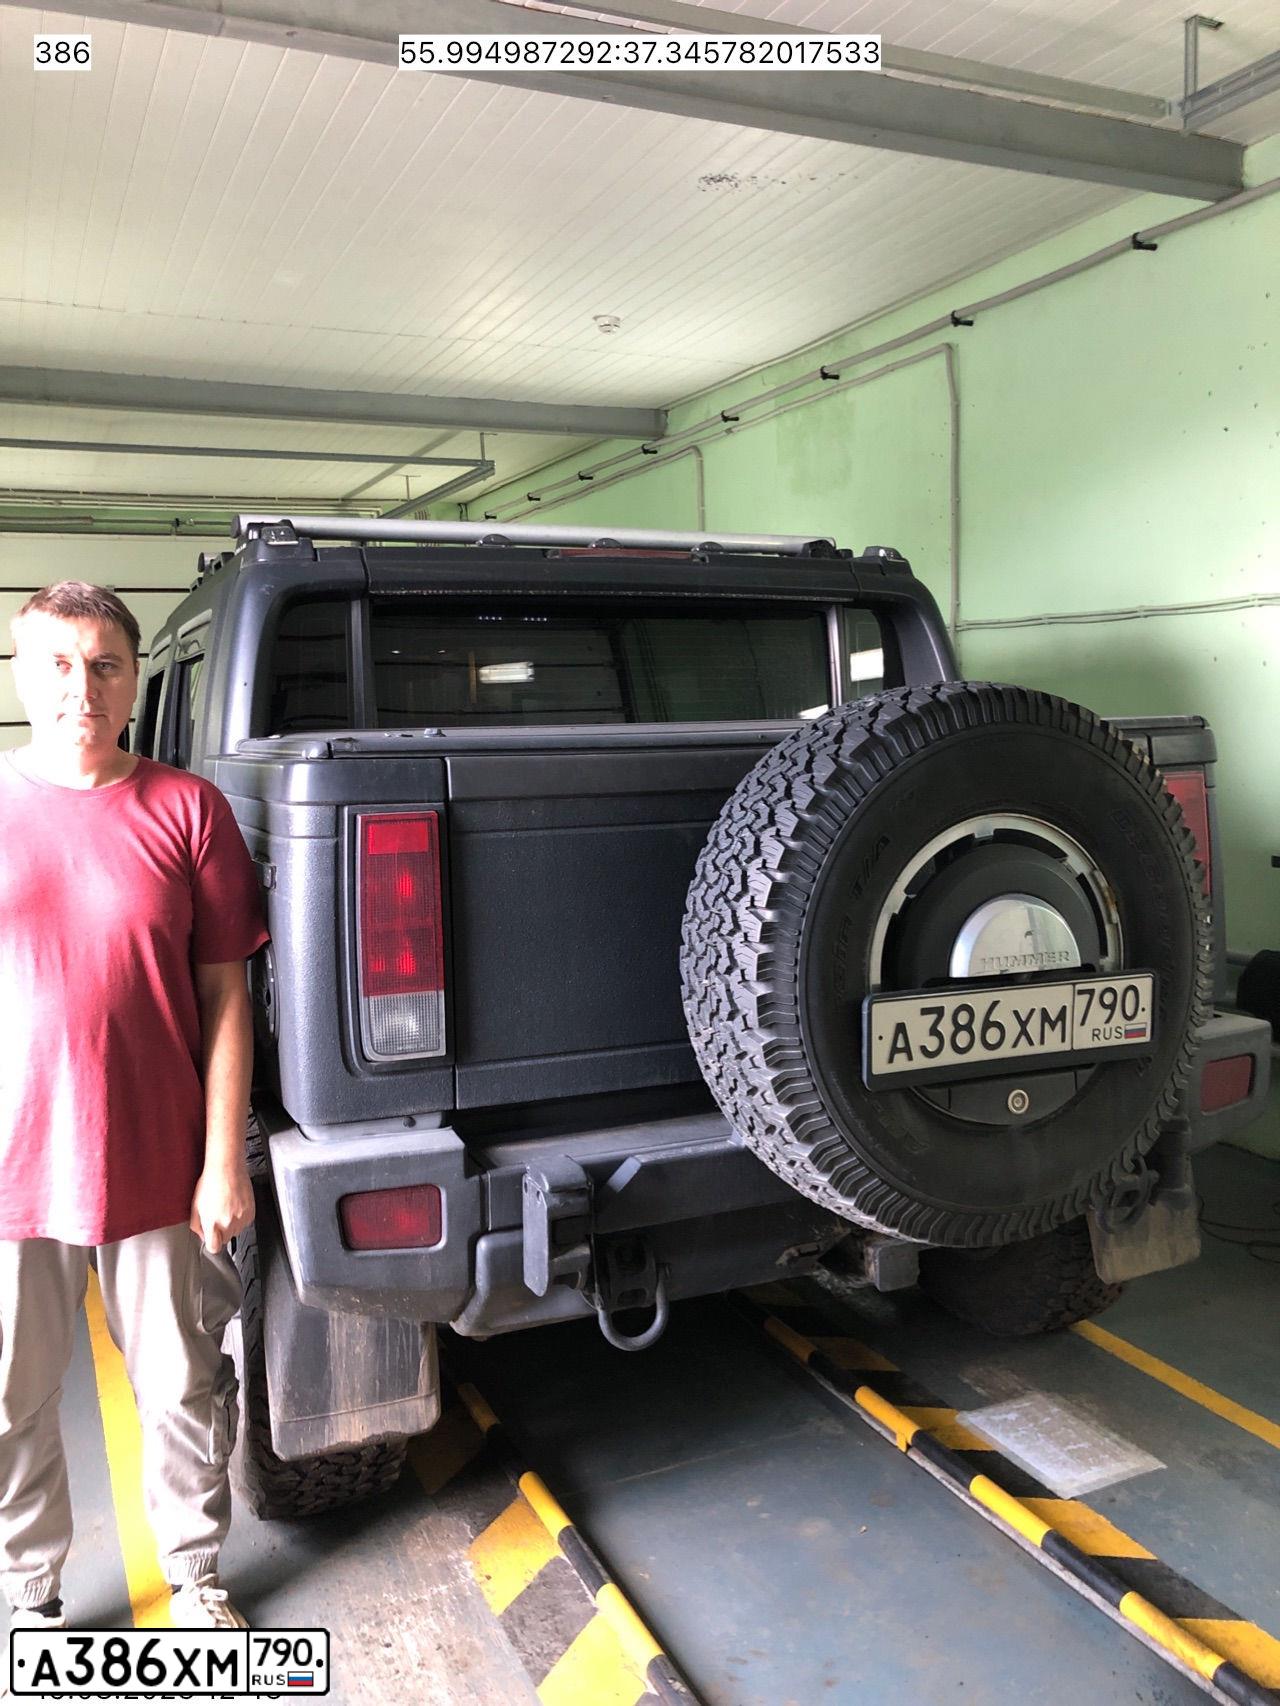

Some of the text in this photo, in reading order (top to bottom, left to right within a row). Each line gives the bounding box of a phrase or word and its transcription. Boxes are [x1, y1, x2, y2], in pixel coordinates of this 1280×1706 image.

[981, 950, 1070, 970] HUMMER
[1077, 984, 1140, 1027] 790
[1091, 1025, 1123, 1042] RUS
